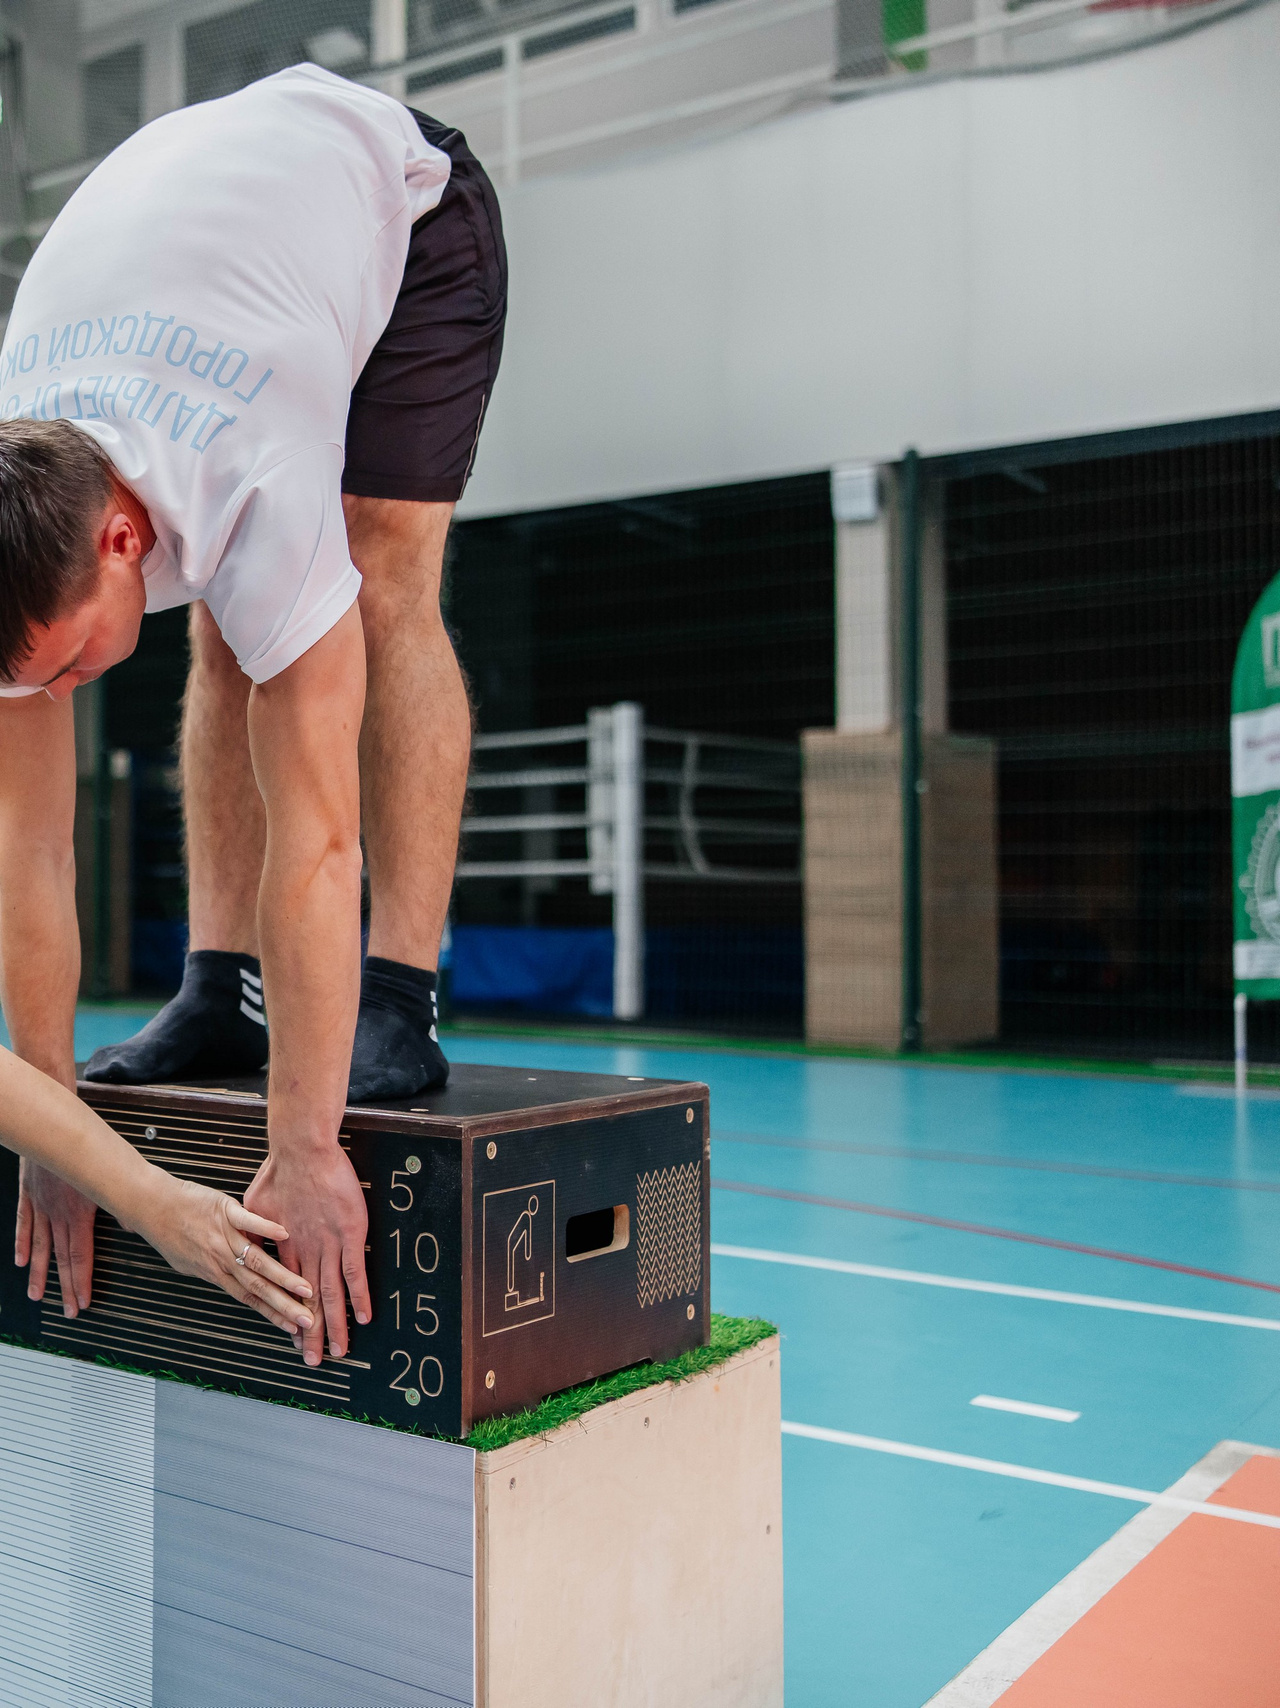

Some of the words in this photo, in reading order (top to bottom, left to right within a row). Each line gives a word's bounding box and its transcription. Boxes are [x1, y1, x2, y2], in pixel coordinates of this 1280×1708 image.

[47, 310, 274, 405] ГОРОДСКОЙ
[389, 1170, 414, 1212] 5
[389, 1228, 440, 1274] 10
[389, 1290, 440, 1336] 15
[389, 1350, 444, 1398] 20
